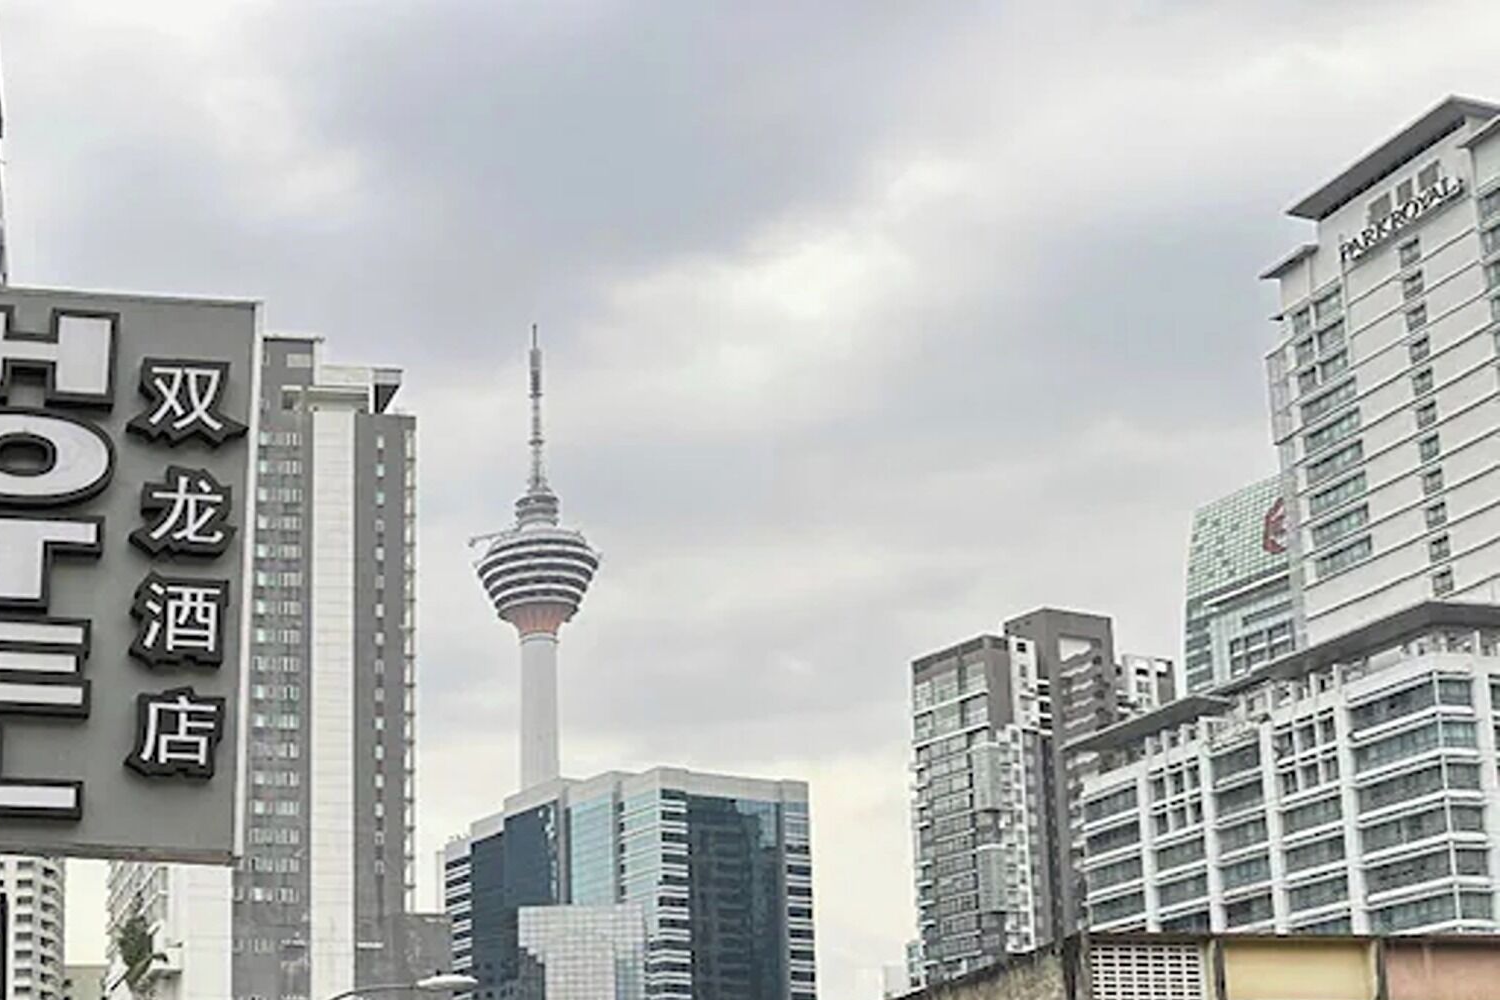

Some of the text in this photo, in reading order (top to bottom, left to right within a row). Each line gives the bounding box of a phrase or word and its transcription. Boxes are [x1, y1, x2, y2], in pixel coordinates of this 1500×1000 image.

[1340, 177, 1462, 262] PARKROYAL
[134, 361, 238, 774] 双龙酒店
